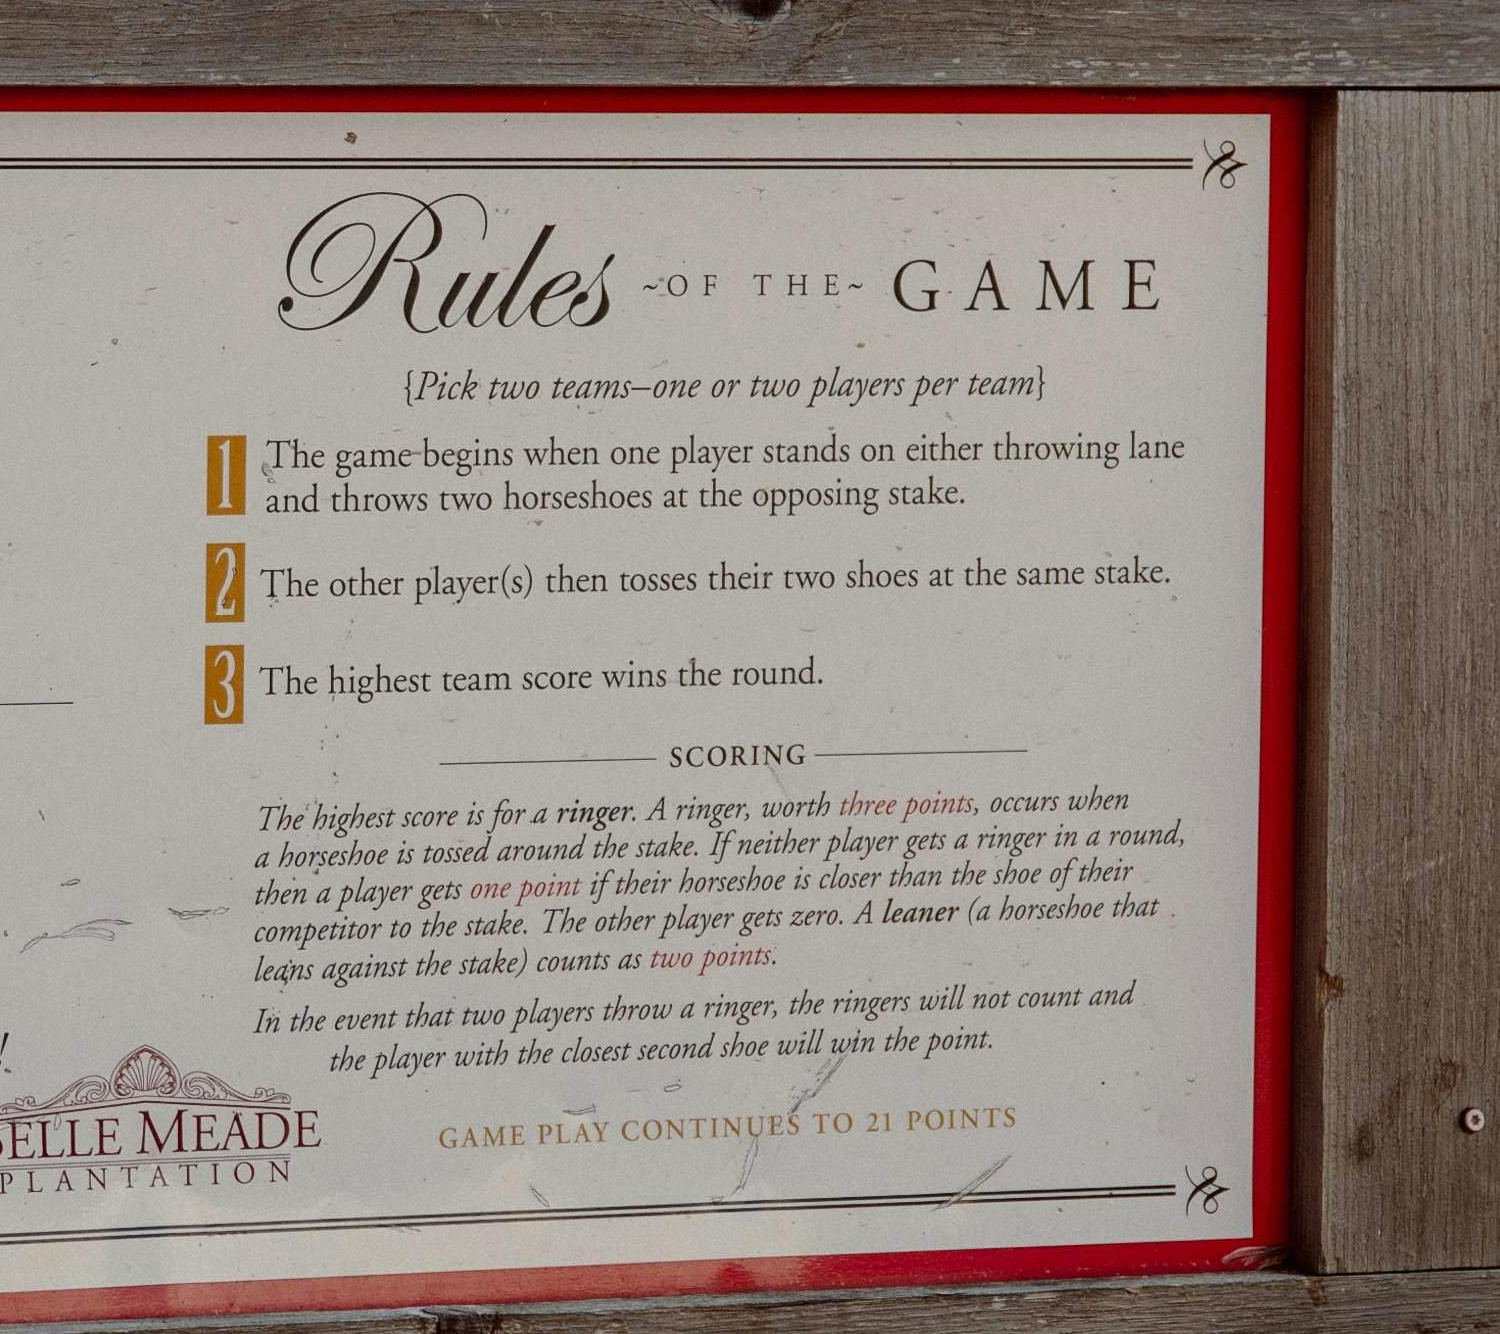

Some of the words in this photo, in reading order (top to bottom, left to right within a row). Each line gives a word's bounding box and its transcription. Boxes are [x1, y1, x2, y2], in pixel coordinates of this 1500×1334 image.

[278, 192, 615, 333] Rules
[894, 259, 1159, 312] GAME
[487, 377, 540, 400] two
[710, 378, 741, 398] or
[749, 375, 800, 397] two
[805, 365, 905, 408] players
[908, 374, 959, 407] per
[218, 440, 232, 508] 1
[266, 438, 325, 469] The
[335, 447, 413, 478] game
[423, 436, 514, 477] begins
[523, 435, 599, 465] when
[610, 446, 660, 465] one
[670, 434, 753, 473] player
[762, 432, 849, 463] stands
[860, 443, 894, 462] on
[906, 431, 983, 461] either
[993, 431, 1119, 469] throwing
[1129, 429, 1184, 459] lane
[265, 482, 319, 513] and
[330, 481, 427, 512] throws
[439, 491, 492, 510] two
[503, 478, 652, 510] horseshoes
[663, 488, 688, 507] at
[699, 477, 742, 507] the
[752, 478, 879, 516] opposing
[888, 474, 964, 505] stake.
[215, 547, 236, 616] 2
[259, 567, 318, 602] The
[329, 566, 404, 596] other
[413, 563, 532, 605] player(s)
[545, 562, 608, 593] then
[619, 572, 697, 592] tosses
[708, 560, 773, 590] their
[783, 569, 835, 589] two
[845, 558, 918, 588] shoes
[928, 566, 954, 587] at
[964, 556, 1006, 586] the
[1016, 566, 1084, 585] same
[1094, 554, 1170, 584] stake.
[213, 650, 235, 718] 3
[258, 664, 317, 695] The
[327, 663, 431, 703] highest
[441, 671, 511, 691] team
[521, 670, 592, 690] score
[601, 660, 666, 688] wins
[677, 656, 721, 687] the
[731, 654, 822, 685] round.
[669, 744, 806, 768] SCORING
[258, 803, 308, 831] The
[311, 802, 396, 838] highest
[400, 810, 458, 827] score
[466, 801, 484, 825] is
[485, 798, 526, 834] for
[529, 807, 547, 824] a
[556, 798, 636, 831] ringer.
[644, 795, 666, 821] A
[676, 795, 750, 828] ringer,
[761, 790, 830, 818] worth
[839, 789, 897, 815] three
[900, 791, 978, 823] points,
[989, 795, 1059, 812] occurs
[1068, 784, 1128, 811] when
[254, 878, 307, 905] then
[315, 886, 331, 903] a
[334, 875, 413, 912] player
[416, 881, 462, 909] gets
[470, 882, 511, 899] one
[515, 873, 582, 906] point
[589, 868, 615, 904] if
[615, 868, 672, 894] their
[678, 864, 785, 893] horseshoe
[793, 873, 811, 890] is
[818, 862, 882, 889] closer
[888, 860, 942, 887] than
[951, 859, 987, 885] the
[992, 858, 1042, 885] shoe
[1049, 856, 1078, 891] of
[1078, 856, 1133, 882] their
[253, 954, 314, 986] leans
[321, 953, 408, 988] against
[415, 948, 452, 976] the
[458, 947, 527, 978] stake)
[536, 951, 610, 972] counts
[617, 952, 642, 969] as
[650, 950, 693, 968] two
[697, 942, 776, 976] points.
[252, 1007, 280, 1033] In
[289, 1004, 326, 1032] the
[334, 1009, 398, 1031] event
[404, 1000, 454, 1028] that
[461, 1007, 505, 1026] two
[509, 997, 594, 1033] players
[602, 994, 672, 1021] throw
[679, 1001, 695, 1018] a
[703, 993, 777, 1026] ringer,
[788, 988, 824, 1015] the
[832, 989, 910, 1021] ringers
[919, 983, 966, 1011] will
[972, 990, 1011, 1009] not
[1017, 987, 1082, 1008] count
[1088, 978, 1136, 1006] and
[136, 1109, 321, 1155] MEADE
[438, 1124, 525, 1148] GAME
[537, 1121, 609, 1145] PLAY
[620, 1113, 800, 1142] CONTINUES
[811, 1112, 853, 1134] TO
[866, 1112, 891, 1132] 21
[906, 1106, 1015, 1131] POINTS
[0, 1160, 290, 1194] PLANTATION
